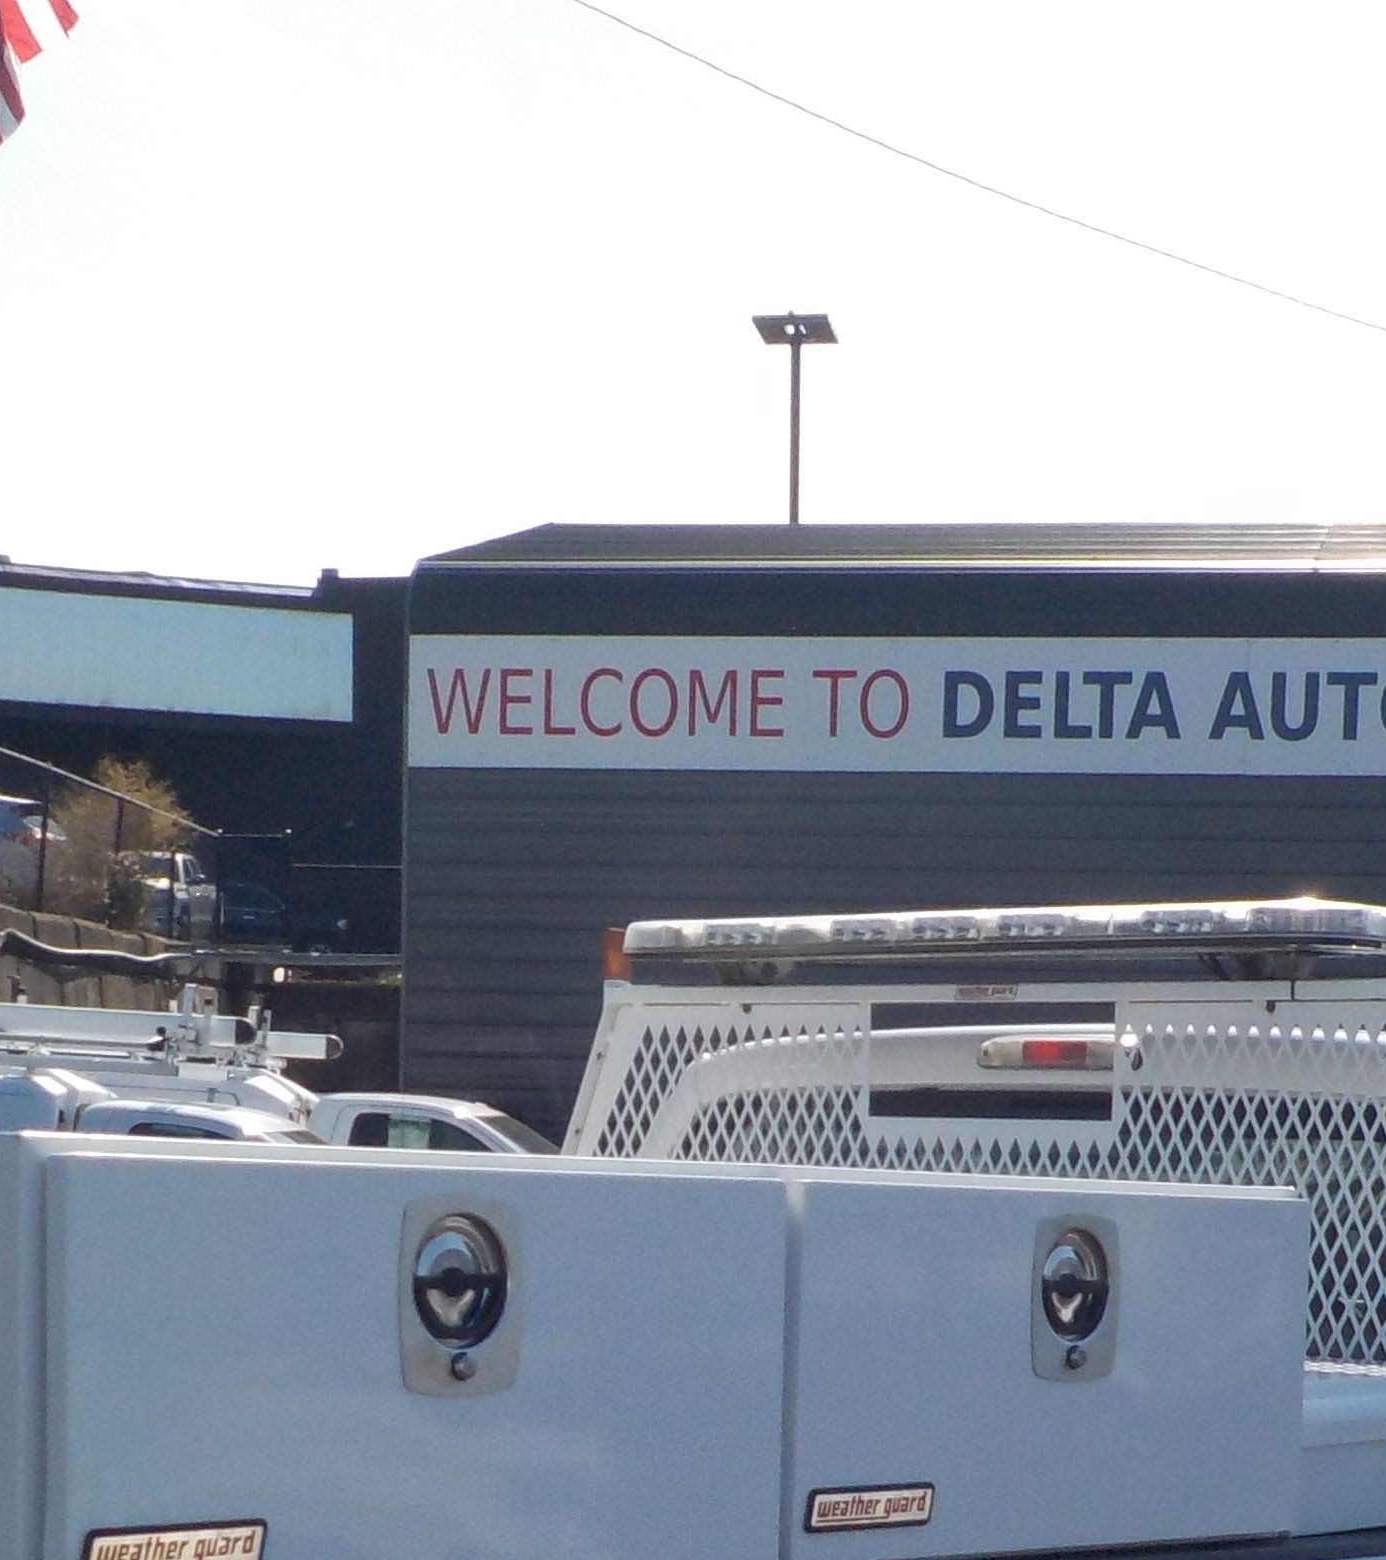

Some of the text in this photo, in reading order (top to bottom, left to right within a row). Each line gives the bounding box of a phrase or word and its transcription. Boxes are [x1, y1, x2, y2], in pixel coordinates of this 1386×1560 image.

[427, 667, 785, 738] WELCOME
[812, 669, 911, 738] TO
[941, 670, 1182, 740] DELTA
[816, 1490, 929, 1519] weather guard
